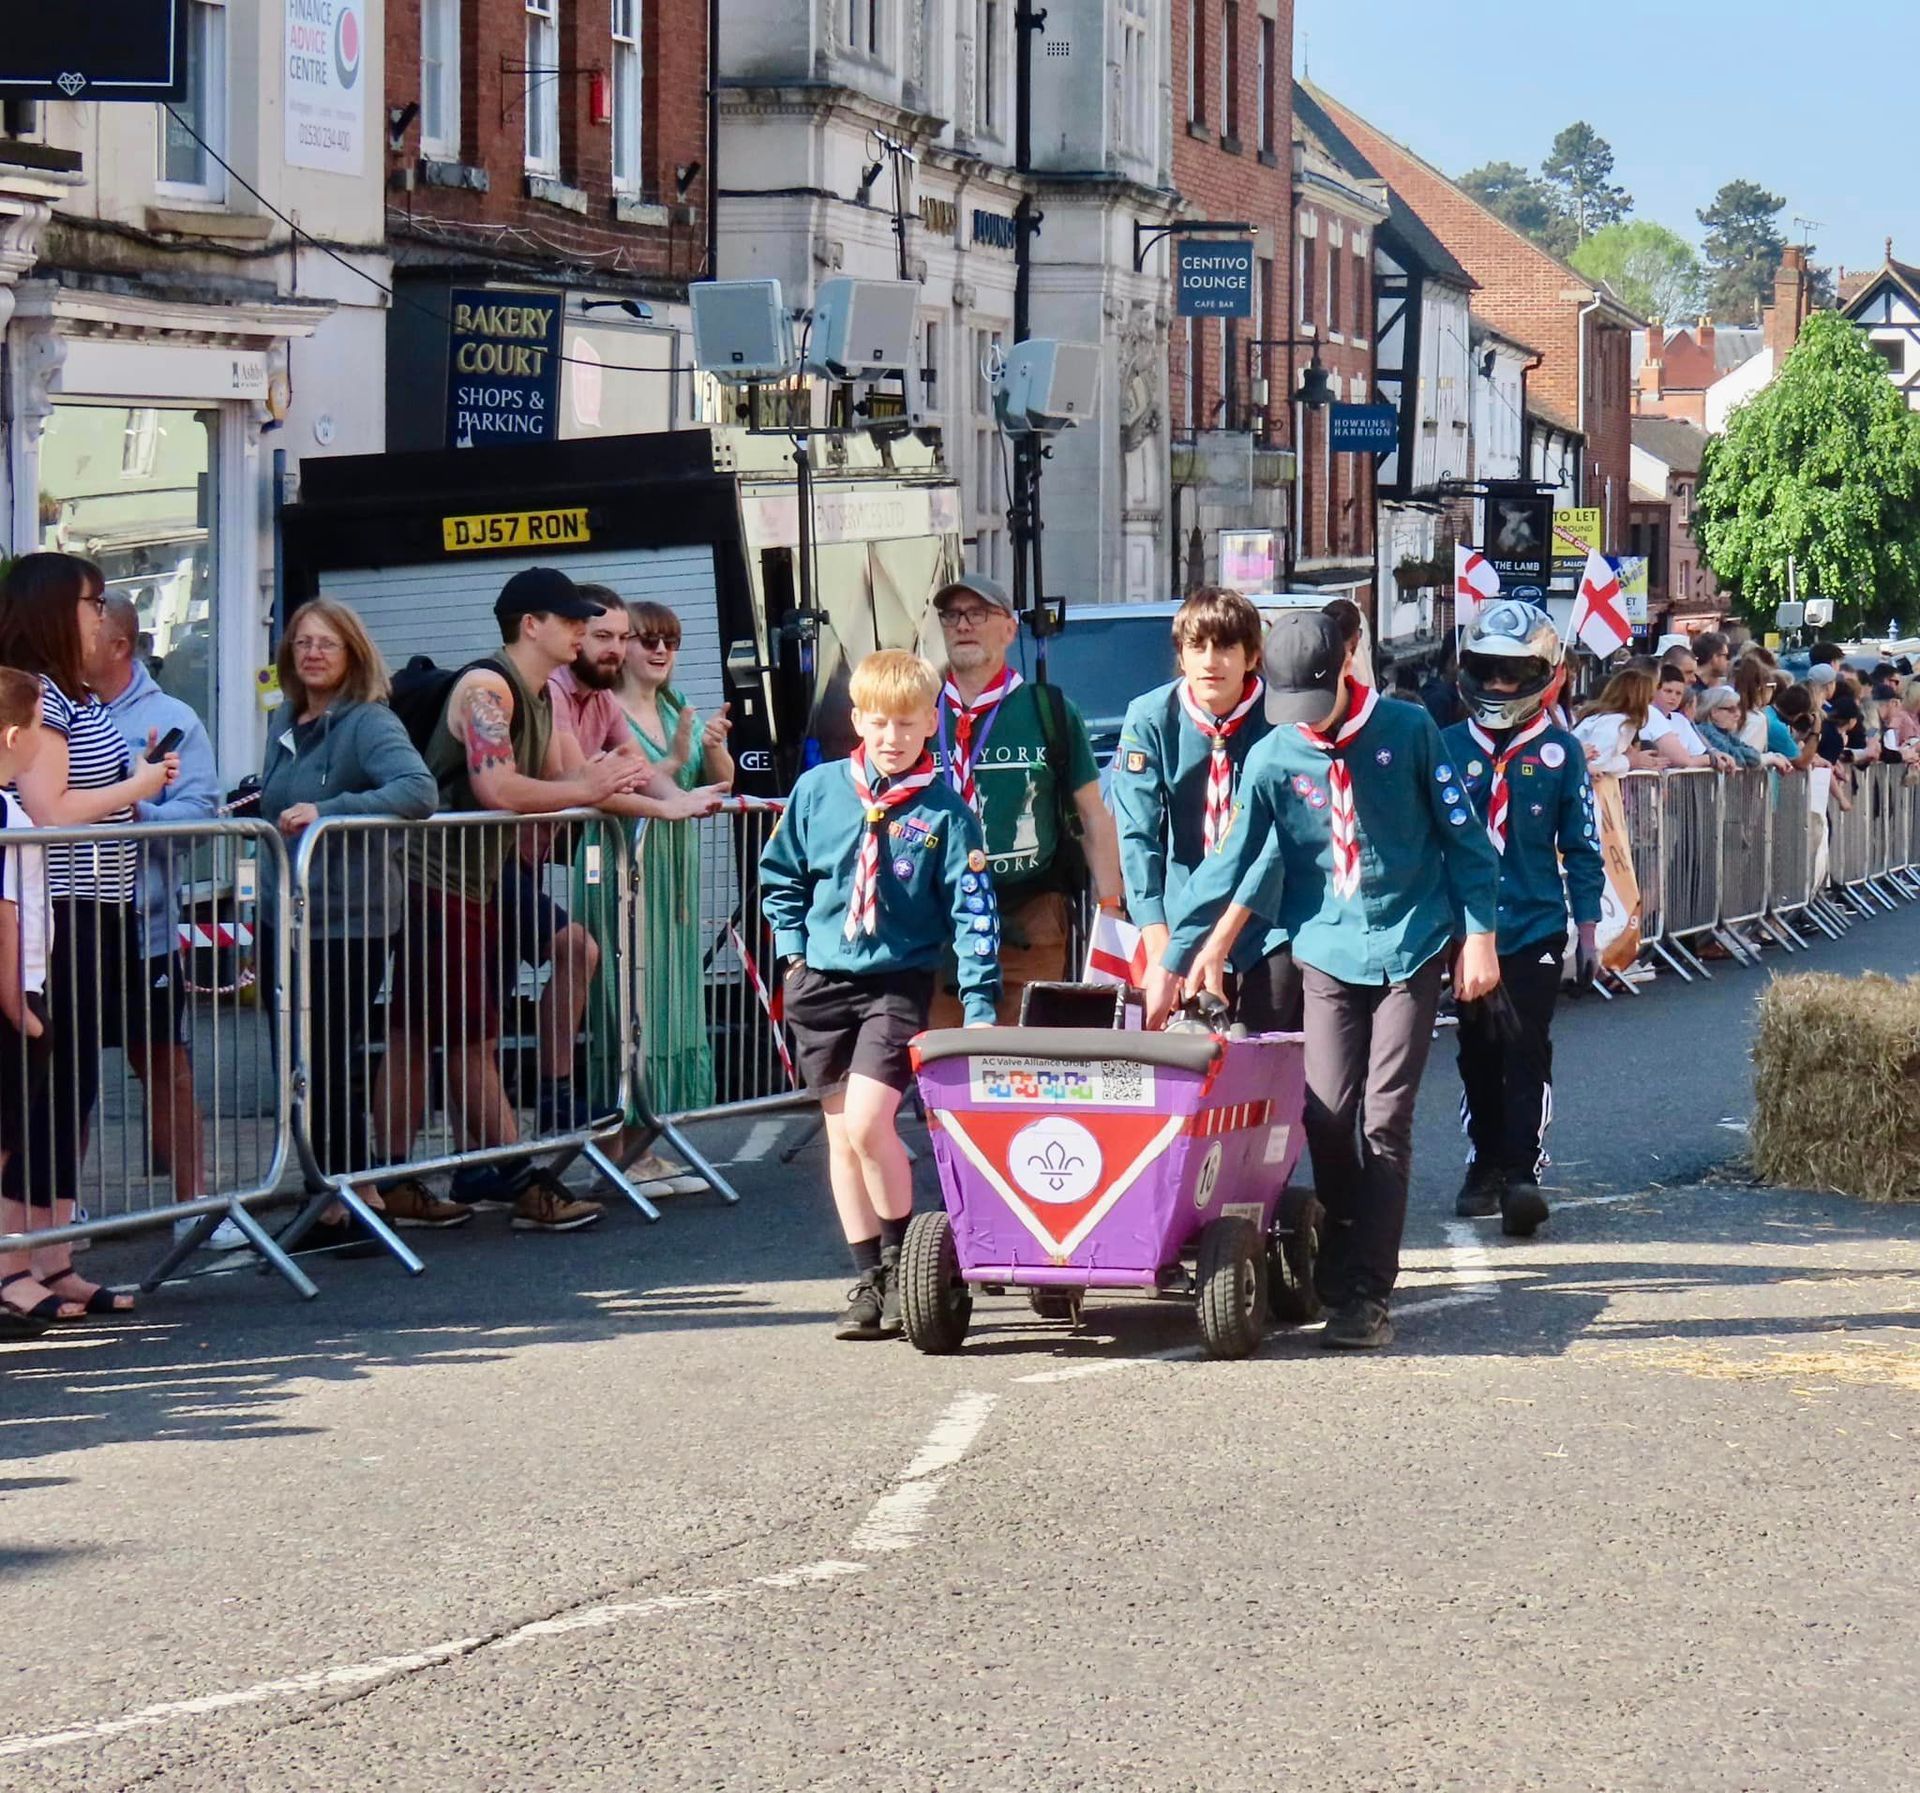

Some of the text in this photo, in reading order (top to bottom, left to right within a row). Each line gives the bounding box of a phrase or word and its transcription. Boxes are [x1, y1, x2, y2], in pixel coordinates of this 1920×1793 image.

[289, 0, 332, 26] FINANCE
[289, 24, 327, 55] ADVICE
[289, 54, 327, 85] CENTRE
[1182, 256, 1248, 270] CENTIVO
[1183, 276, 1246, 288] LOUNGE
[455, 304, 553, 339] BAKERY
[457, 342, 548, 377] COURT
[458, 387, 544, 409] SHOPS &
[458, 411, 543, 434] PARKING
[1334, 419, 1386, 428] HOWKINS
[1334, 428, 1391, 436] HARRISON
[1553, 511, 1596, 522] TO LET
[454, 513, 579, 545] DJ57 RON
[1494, 560, 1540, 572] THE LAMB
[979, 746, 1047, 763] YORK
[993, 854, 1039, 874] ORK
[981, 1058, 996, 1066] AC
[998, 1058, 1022, 1067] Valve
[1023, 1058, 1061, 1067] Alliance
